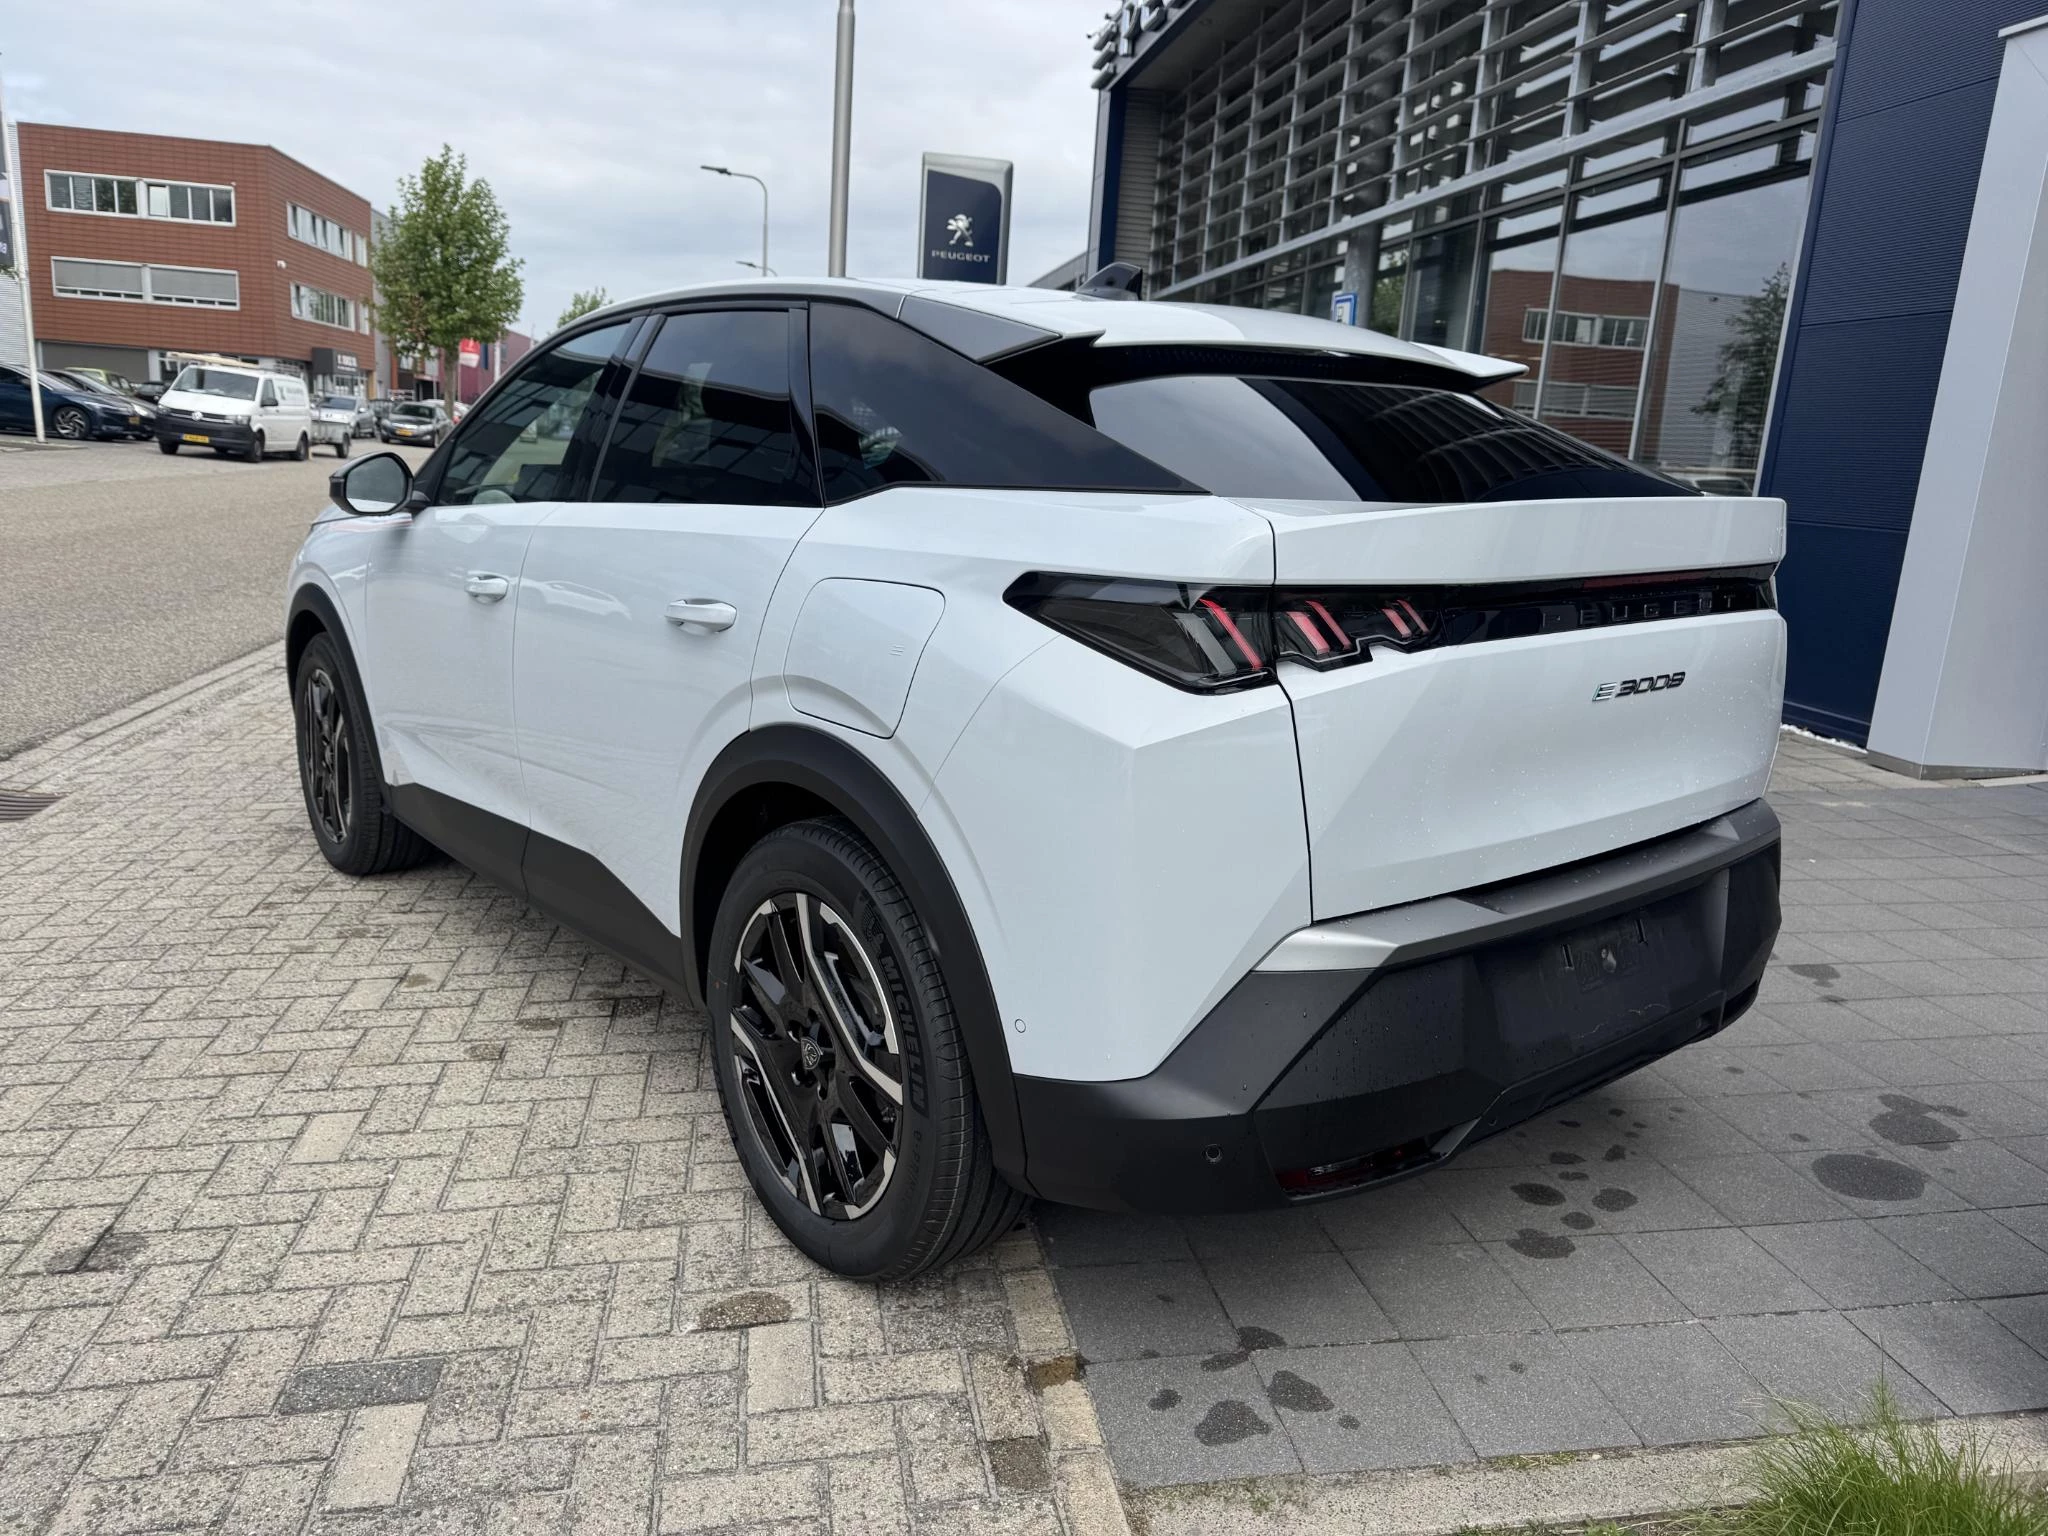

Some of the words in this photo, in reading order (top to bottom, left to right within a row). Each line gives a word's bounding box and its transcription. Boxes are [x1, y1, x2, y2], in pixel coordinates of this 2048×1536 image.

[931, 249, 991, 263] PEUGEOT
[1541, 593, 1736, 629] PEUGEOT
[879, 953, 927, 1112] MICHELIN
